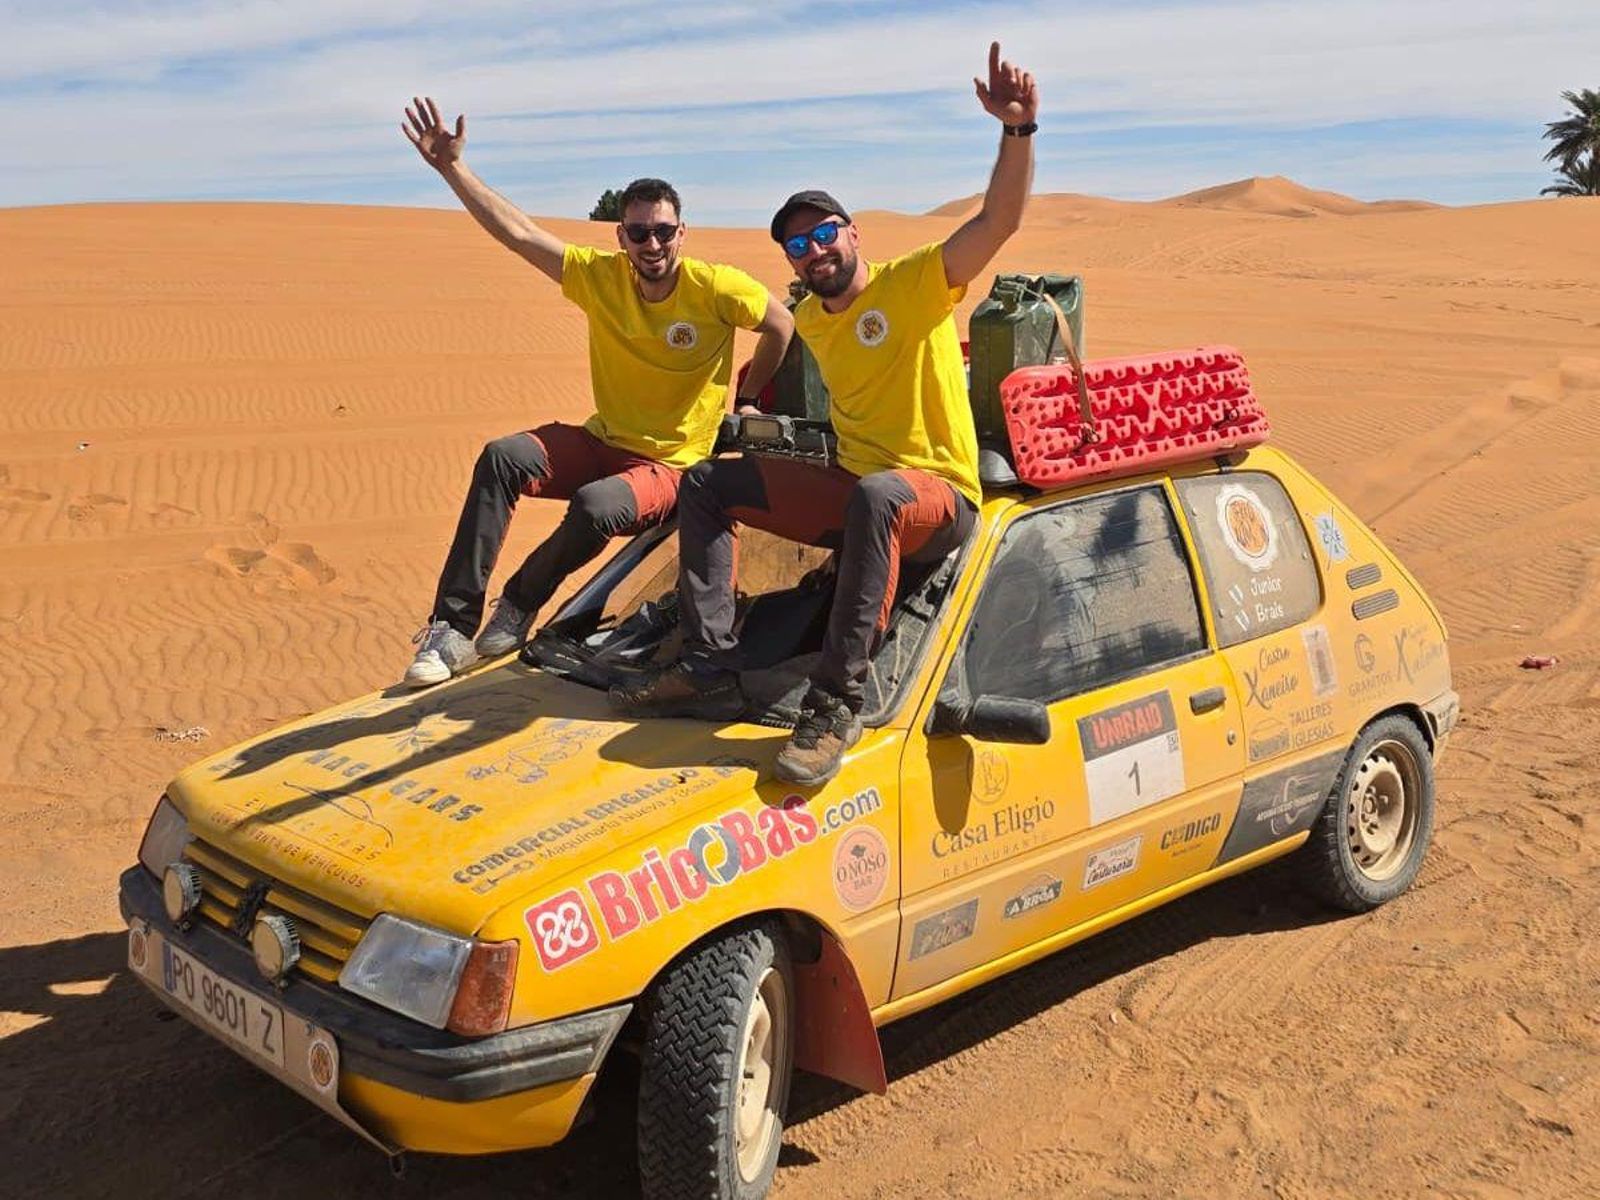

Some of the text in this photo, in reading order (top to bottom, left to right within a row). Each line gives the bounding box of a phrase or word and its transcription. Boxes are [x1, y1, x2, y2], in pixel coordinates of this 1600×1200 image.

[1250, 576, 1282, 596] Junior
[1256, 601, 1284, 622] Brais
[1289, 703, 1333, 727] TALLERES
[1292, 721, 1335, 749] IGLESIAS
[1128, 761, 1142, 797] 1
[931, 795, 1055, 858] Casa Eligio
[836, 852, 887, 883] O NOSO
[172, 953, 276, 1055] PO 9601 Z
